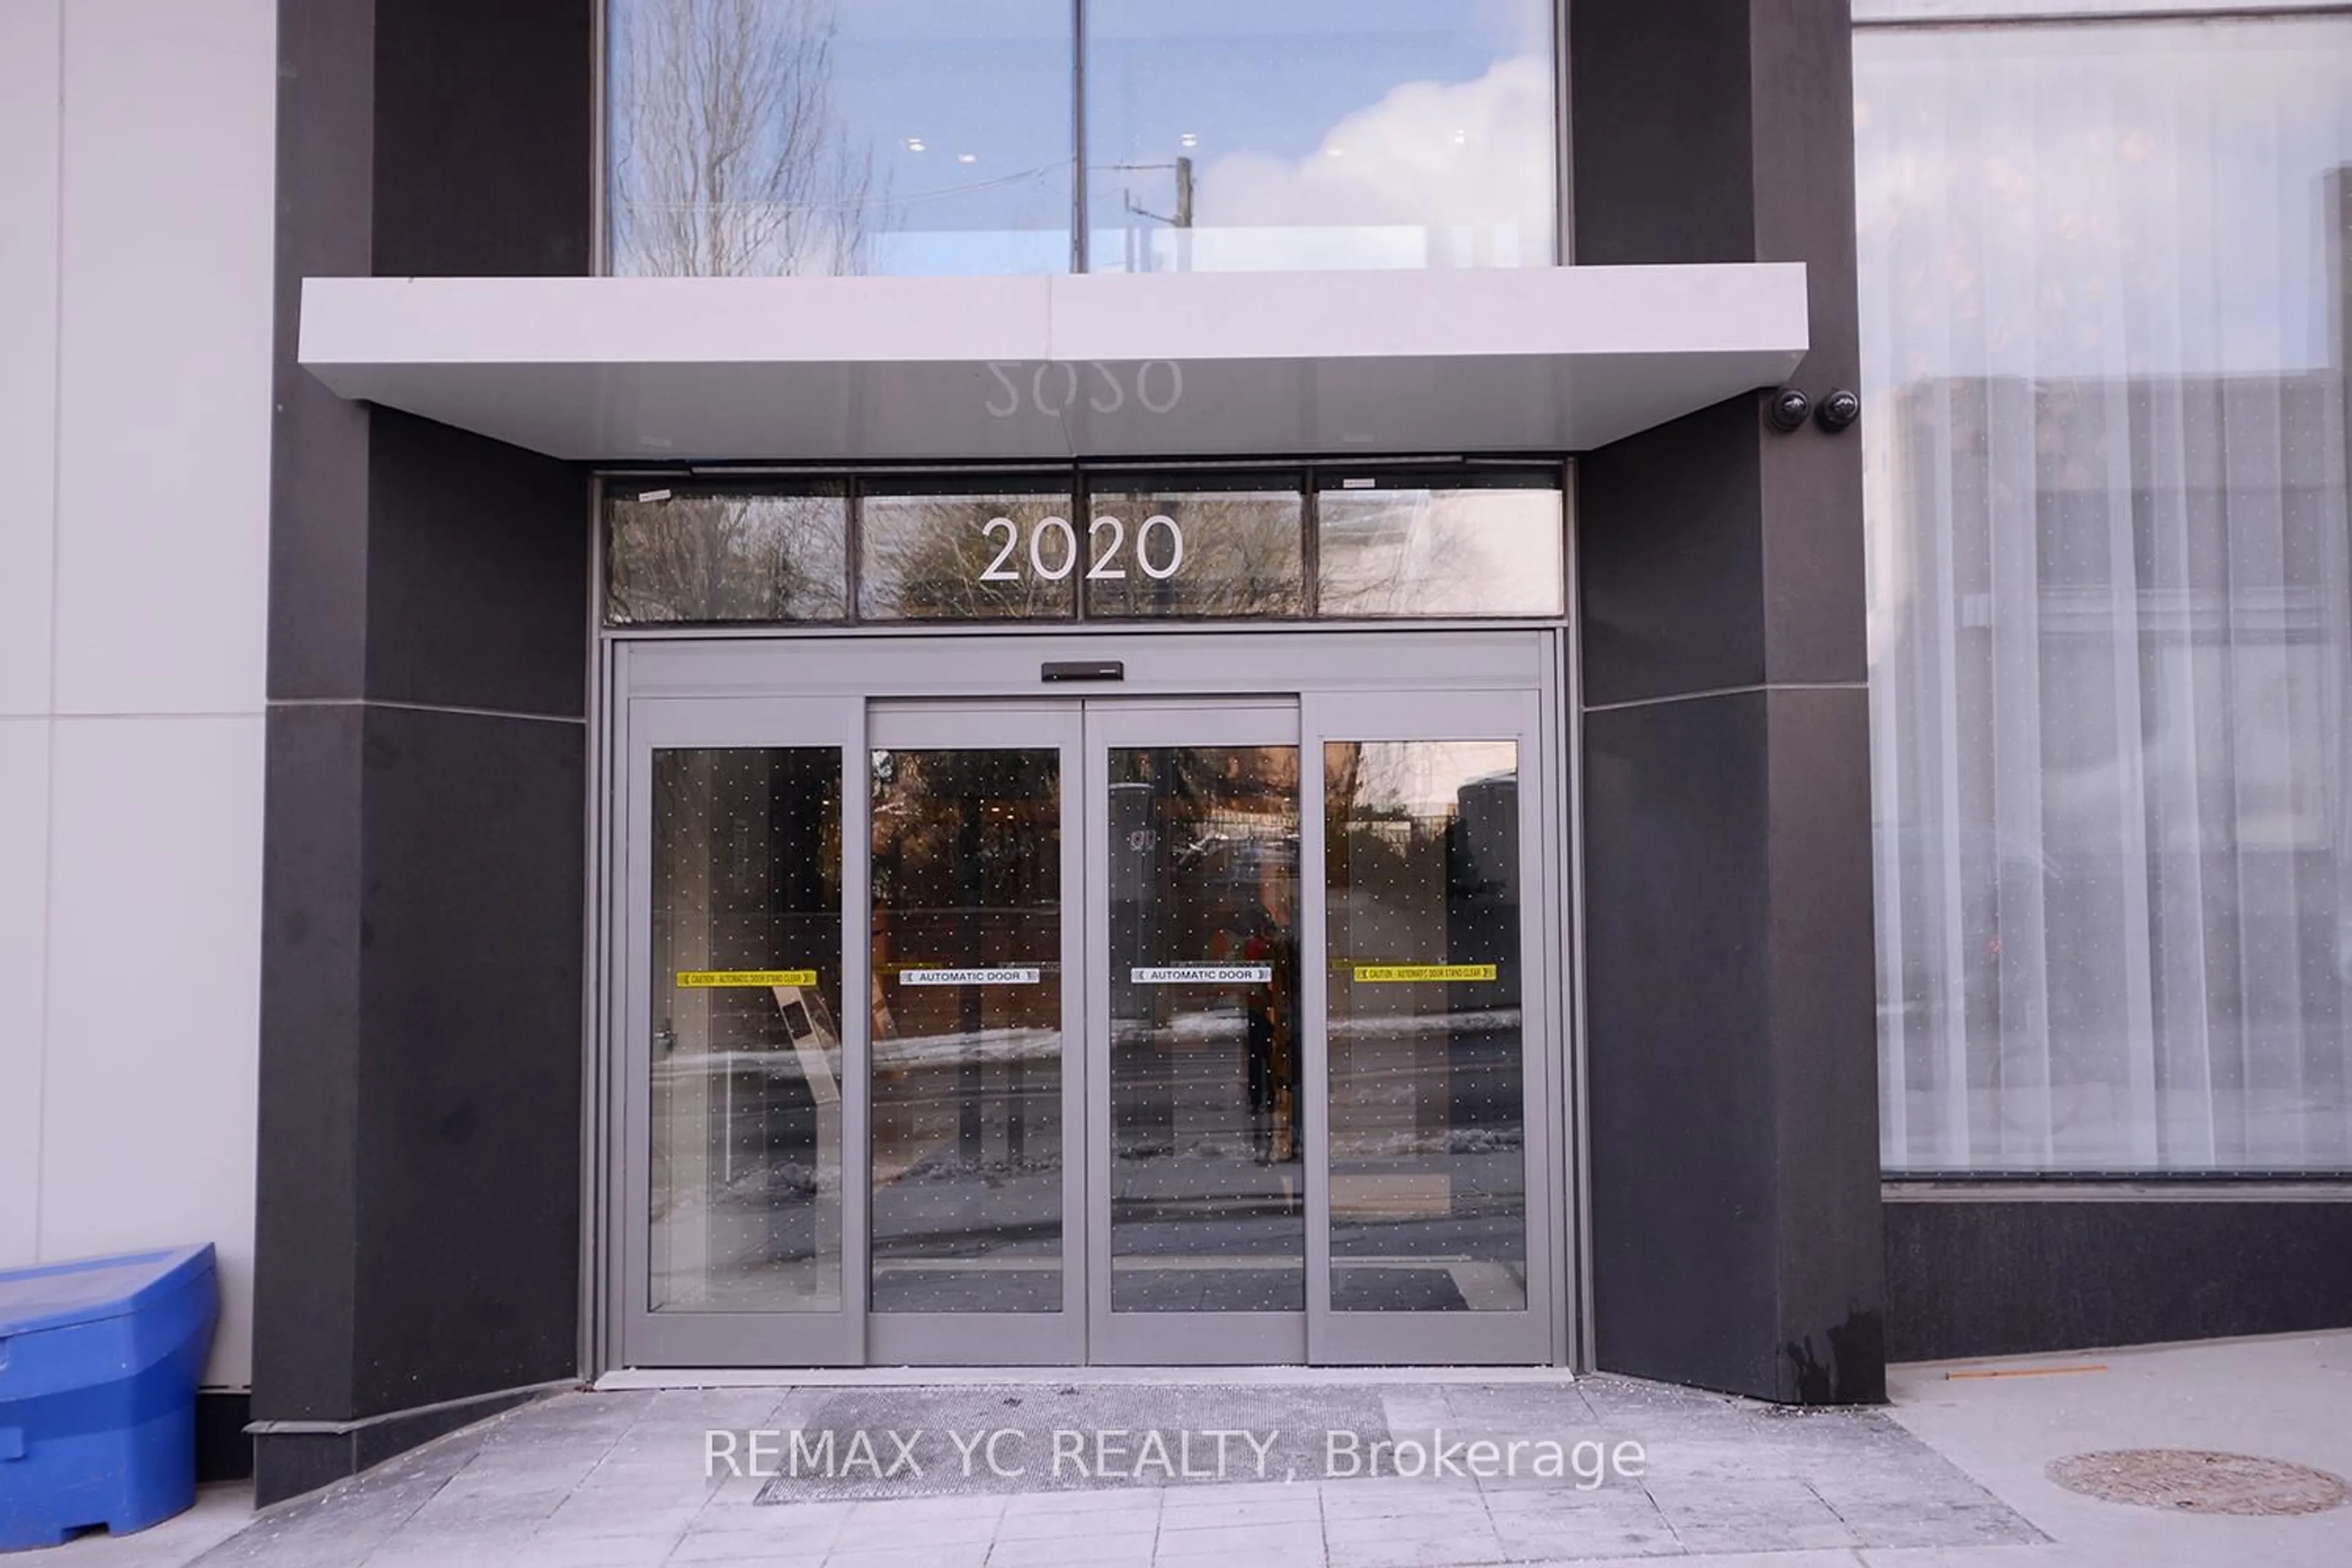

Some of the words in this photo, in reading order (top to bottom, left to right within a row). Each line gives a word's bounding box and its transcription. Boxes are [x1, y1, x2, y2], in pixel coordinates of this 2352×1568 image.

[980, 514, 1183, 580] 2020
[919, 973, 983, 981] AUTOMATIC
[987, 972, 1020, 981] DOOR
[1151, 970, 1216, 979] AUTOMATIC
[1219, 970, 1253, 979] DOOR
